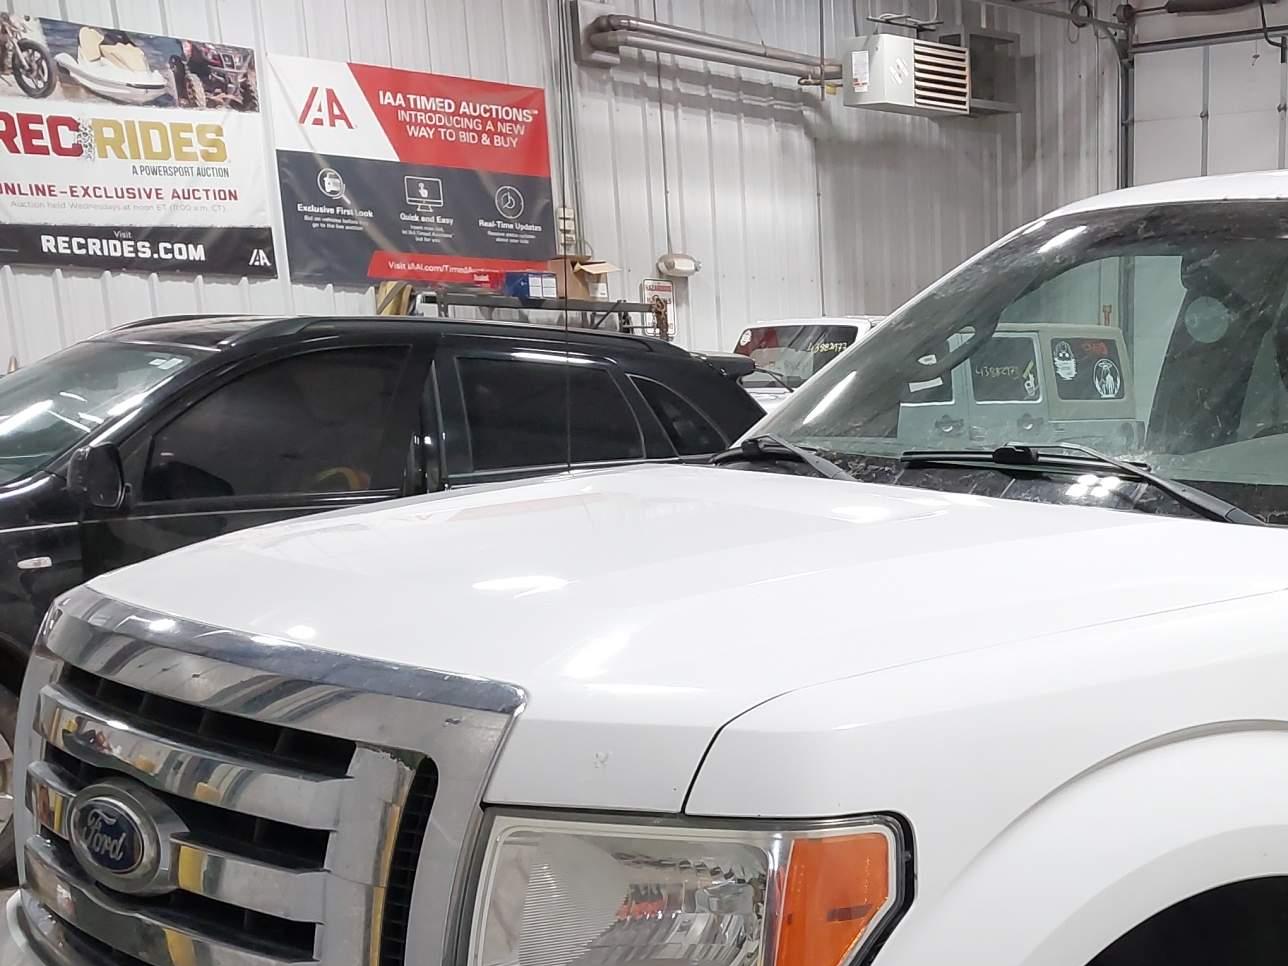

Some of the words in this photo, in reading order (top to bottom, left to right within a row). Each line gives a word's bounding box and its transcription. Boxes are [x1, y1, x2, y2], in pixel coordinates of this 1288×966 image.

[378, 90, 405, 108] IAA
[407, 94, 455, 113] TIMED
[398, 109, 483, 131] INTRODUCING
[485, 122, 495, 132] A
[497, 123, 525, 136] NEW
[91, 118, 228, 162] RIDES
[406, 124, 436, 139] WAY
[438, 128, 456, 141] TO
[458, 131, 478, 144] BID
[481, 134, 491, 145] &
[493, 134, 519, 148] BUY
[132, 164, 139, 176] A
[140, 165, 194, 177] POWERSPORT
[196, 166, 230, 178] AUCTION
[0, 182, 164, 200] NLINE-EXCLUSIVE
[171, 187, 239, 201] AUCTION
[296, 203, 335, 214] Exclusive
[399, 212, 419, 222] Quick
[420, 215, 435, 223] and
[436, 215, 454, 226] Easy
[478, 219, 514, 229] Real-Time
[514, 223, 542, 232] Updates
[113, 230, 132, 239] Visit
[40, 235, 206, 261] RECRIDES.COM
[388, 261, 406, 270] Visit
[82, 808, 127, 861] Ford
